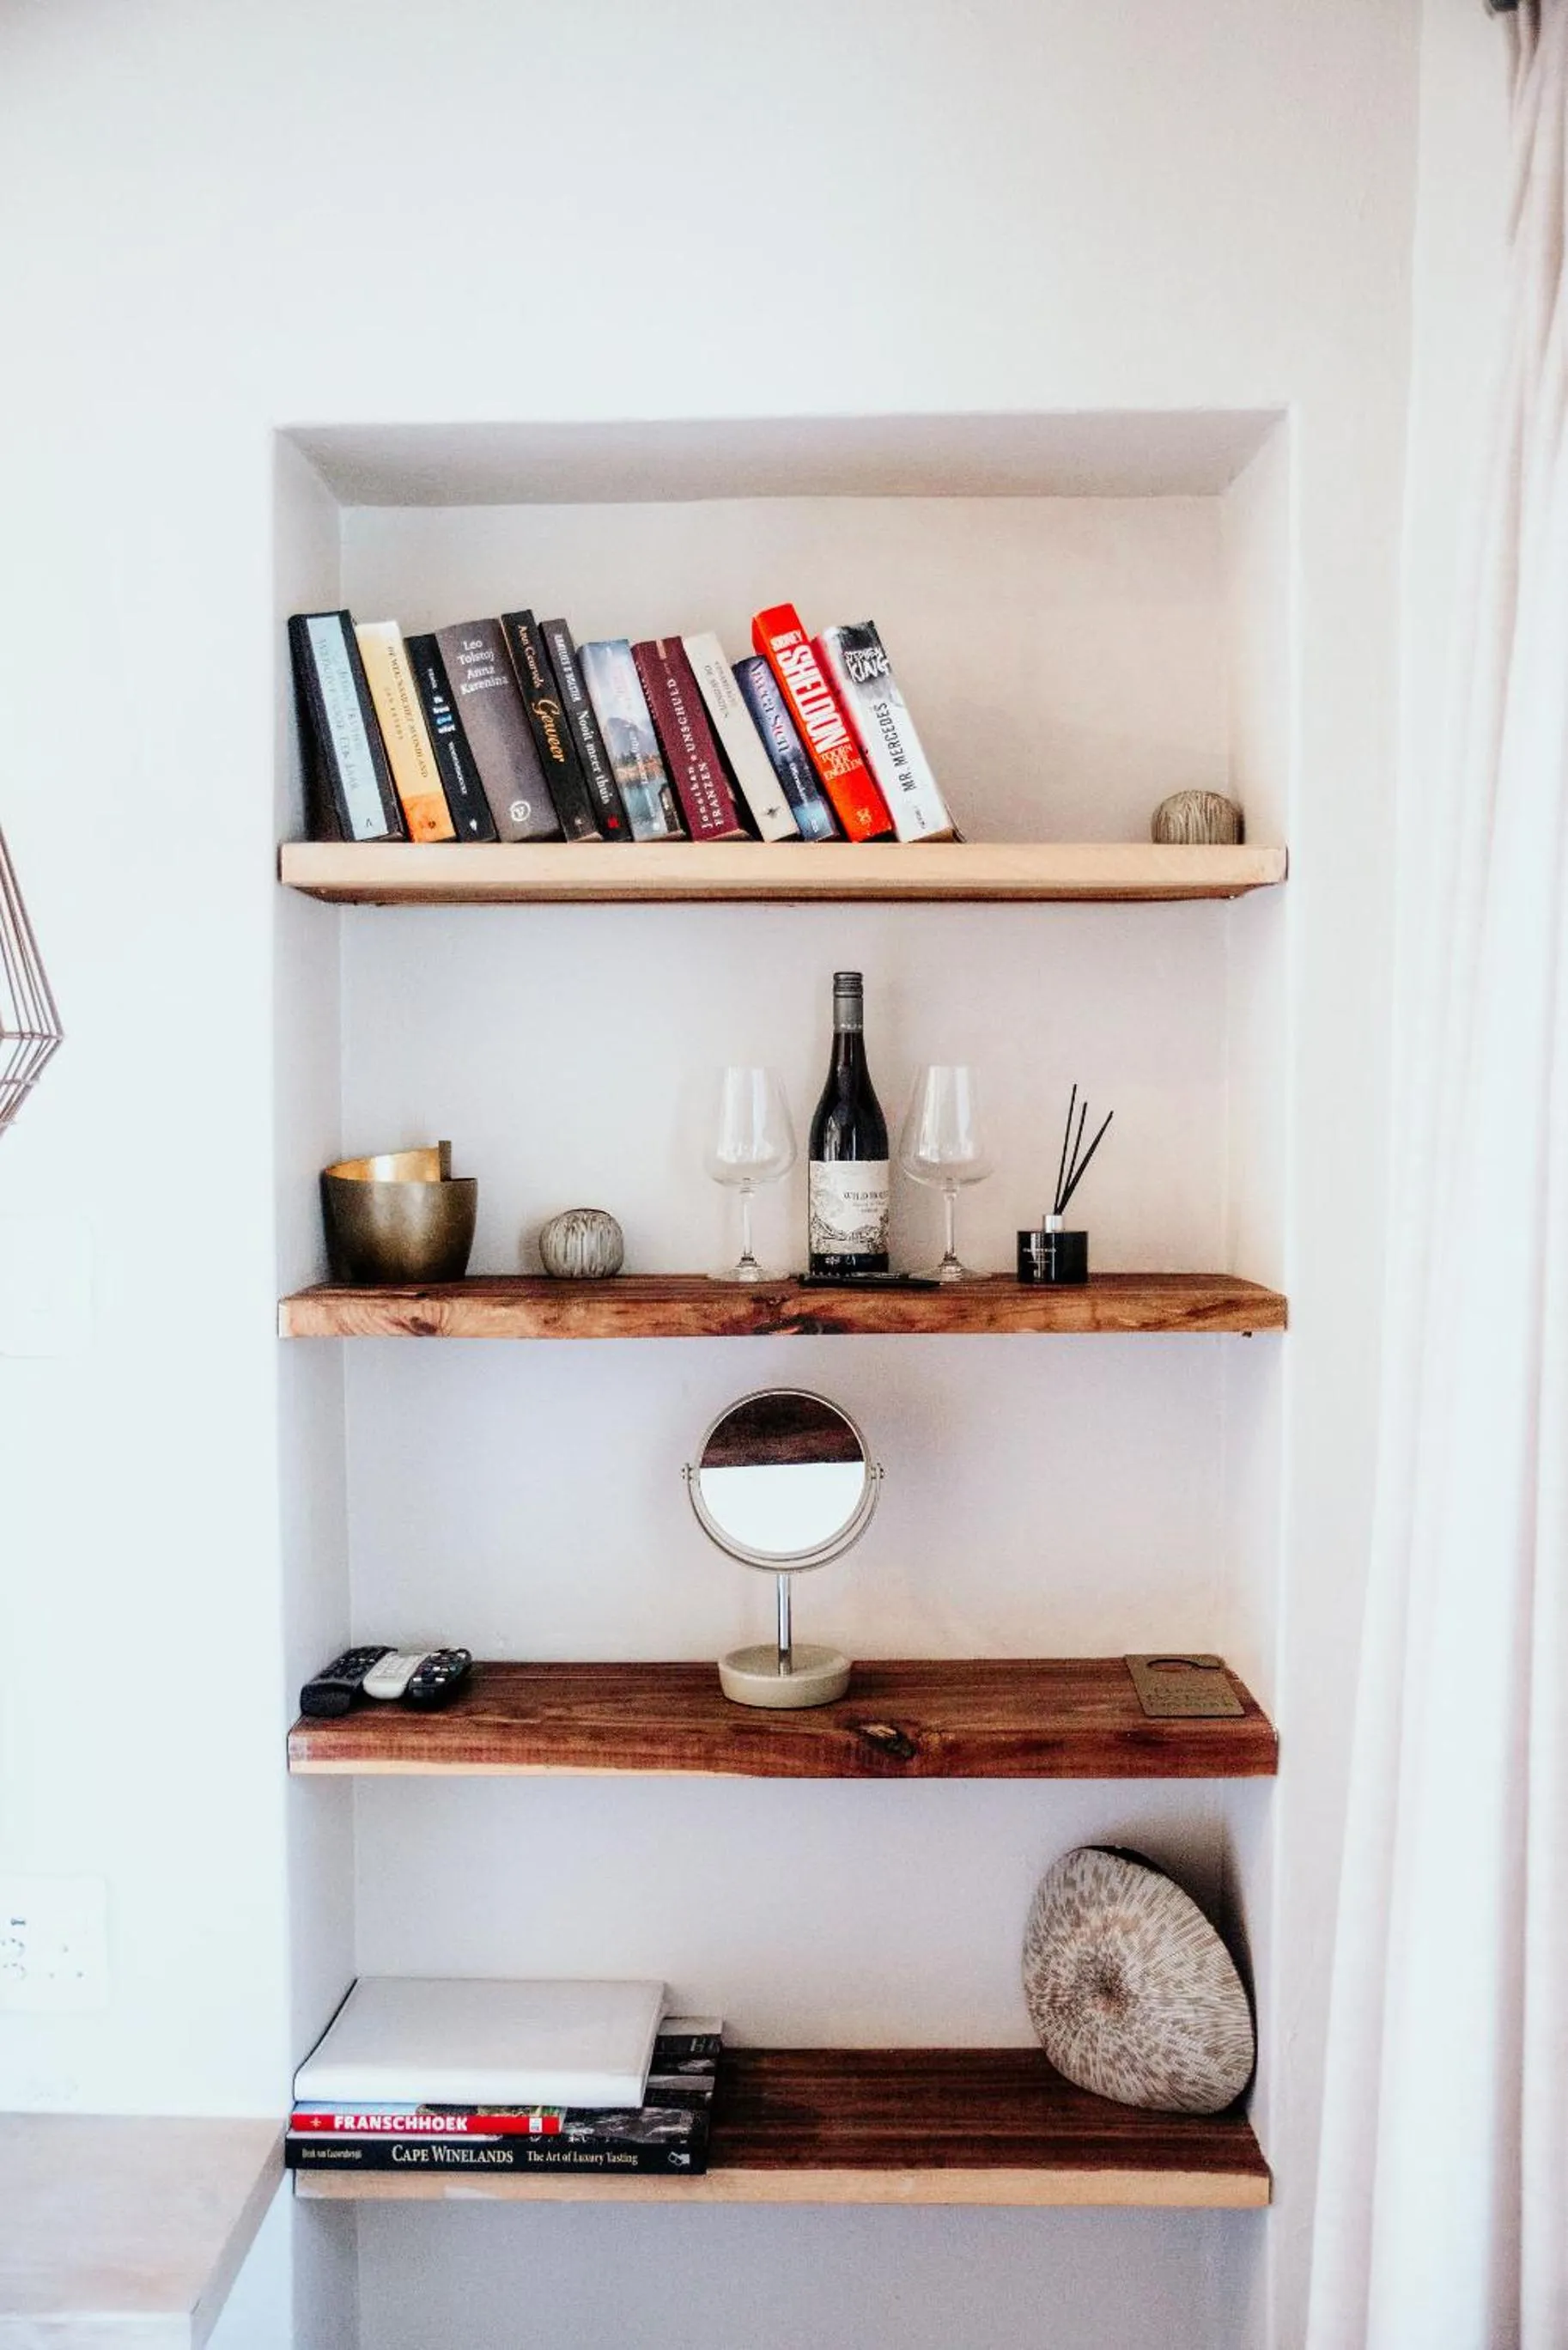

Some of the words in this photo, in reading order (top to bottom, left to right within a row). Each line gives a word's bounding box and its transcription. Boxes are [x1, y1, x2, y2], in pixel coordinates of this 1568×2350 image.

[457, 648, 495, 666] Tolstoj
[463, 638, 483, 652] Leo
[466, 666, 495, 680] Anna
[846, 654, 890, 683] KING
[459, 675, 508, 696] Karenina
[775, 644, 849, 754] SHELDON
[532, 697, 566, 764] Geweer
[577, 709, 594, 741] Nooit
[666, 678, 696, 753] UNSCHULD
[873, 702, 907, 767] MERCEDES
[585, 741, 602, 773] meer
[594, 772, 611, 805] thuis
[686, 767, 714, 828] Jonathan
[699, 761, 723, 827] FRANZEN
[333, 2115, 468, 2132] FRANSCHHOEK
[391, 2143, 429, 2163] CAPE
[430, 2145, 514, 2164] WINELANDS
[526, 2150, 544, 2162] The
[545, 2151, 562, 2162] Art
[562, 2151, 573, 2162] of
[573, 2151, 604, 2165] Luxury
[605, 2151, 638, 2164] Tasting
